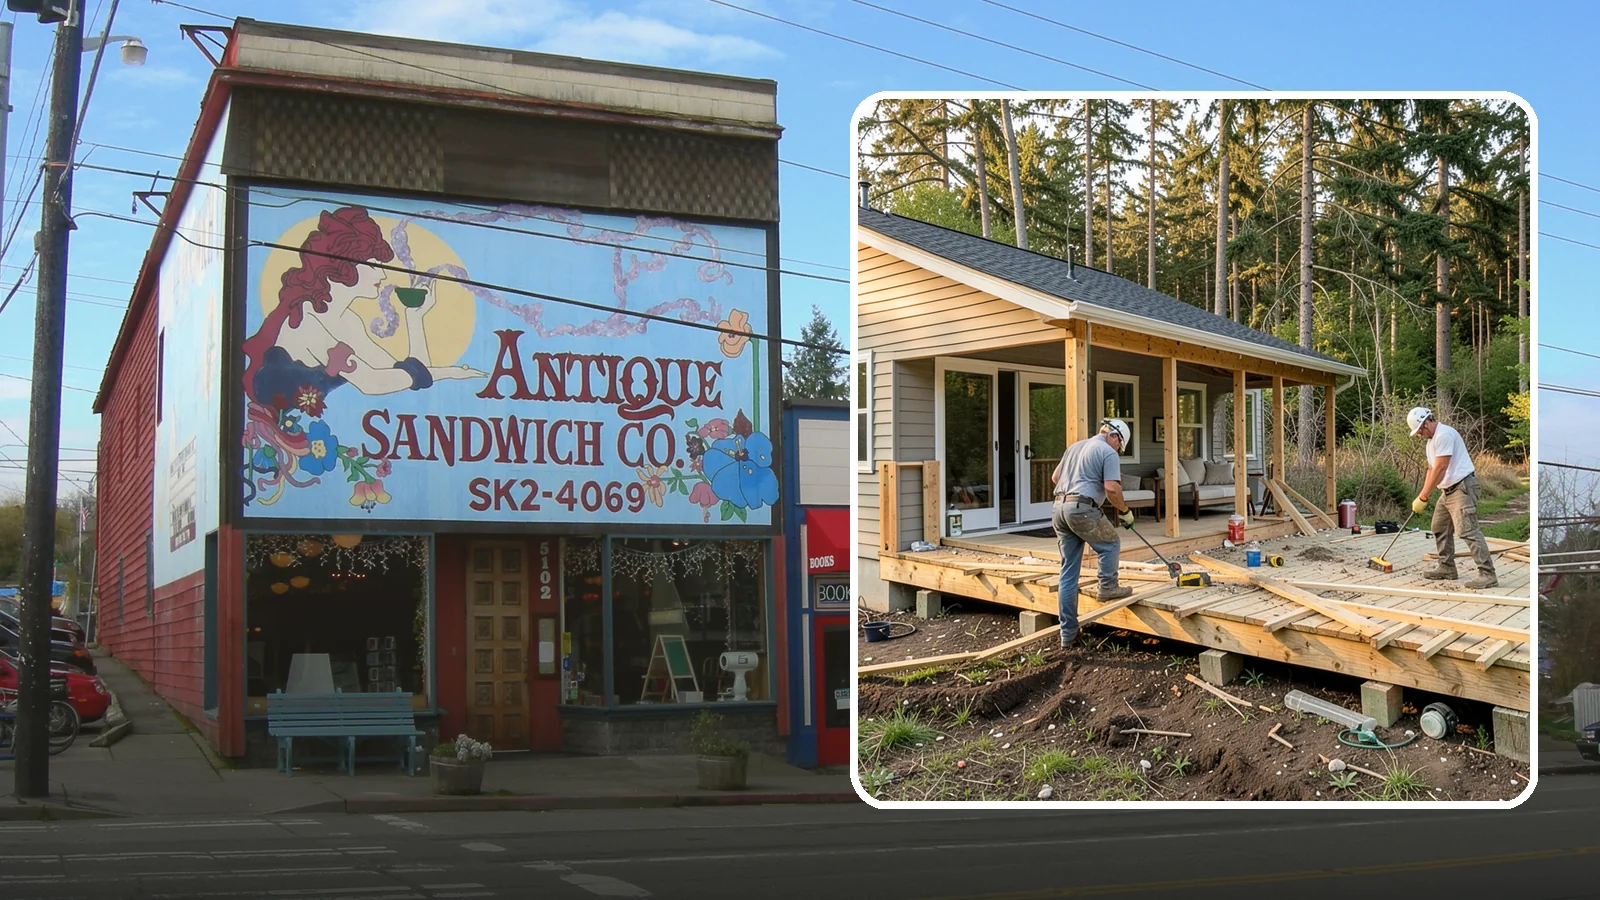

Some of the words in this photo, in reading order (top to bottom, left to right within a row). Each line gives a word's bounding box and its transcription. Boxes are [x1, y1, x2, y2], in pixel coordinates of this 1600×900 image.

[476, 329, 724, 420] ANTIQUE
[361, 409, 604, 467] SANDWICH
[617, 422, 684, 469] CO.
[468, 477, 645, 513] SK2-4069
[540, 541, 551, 600] 5102
[809, 555, 835, 568] BOOKS
